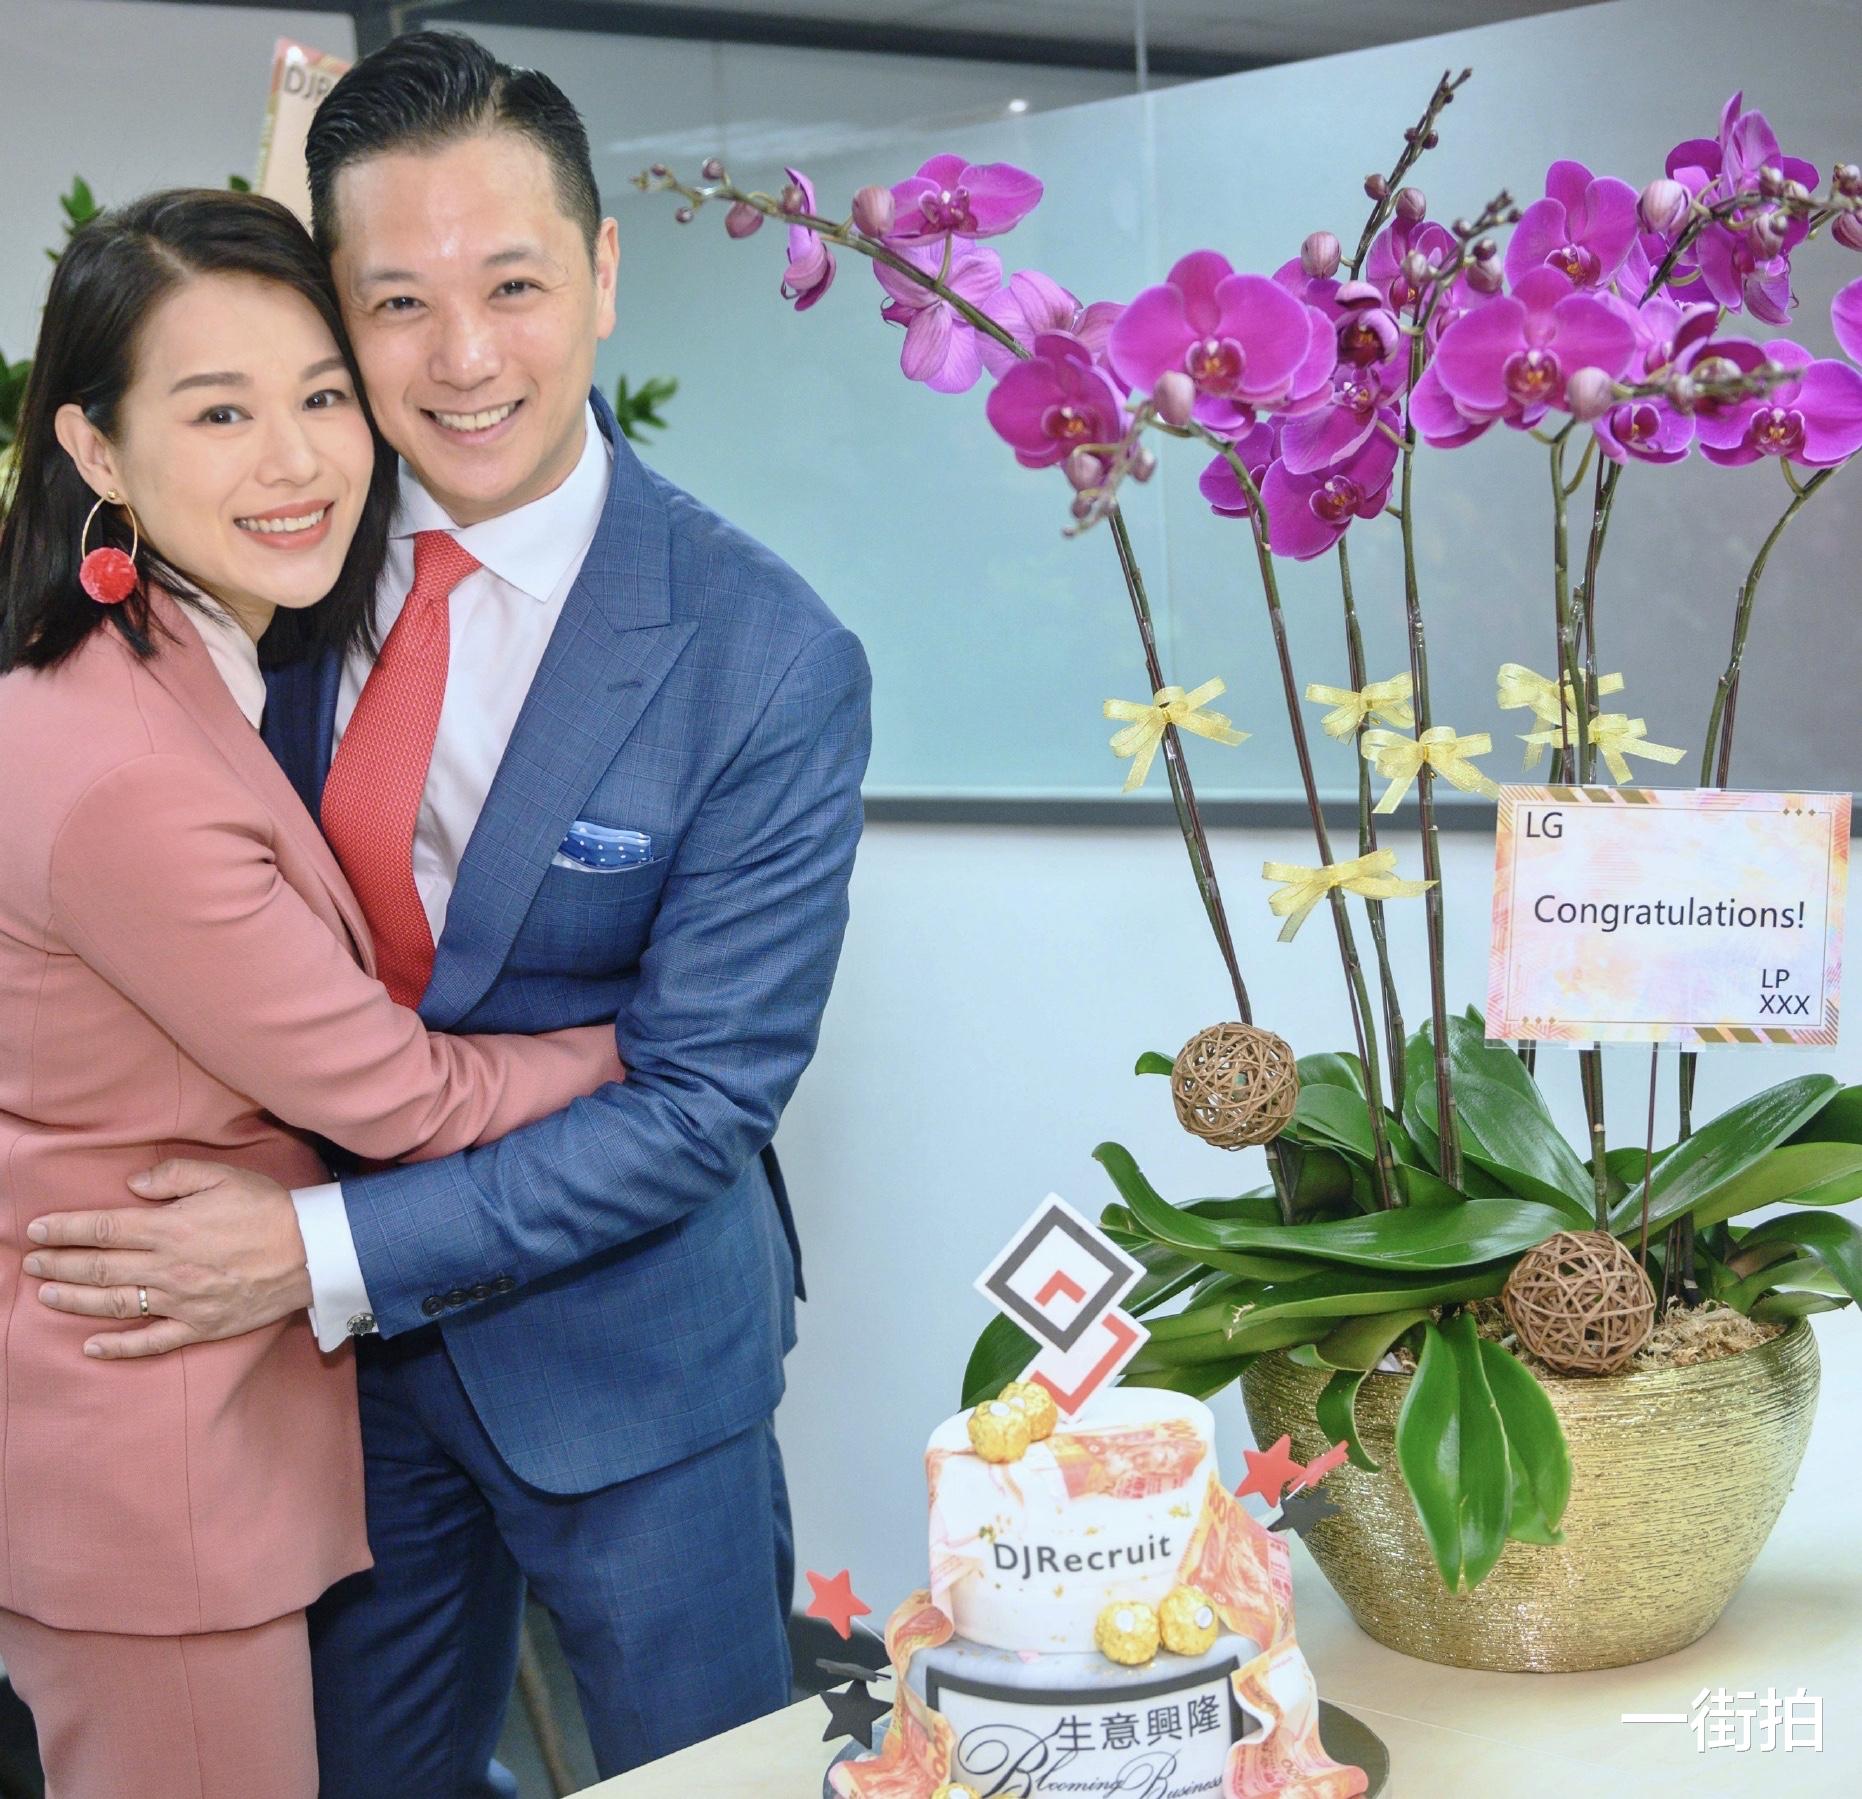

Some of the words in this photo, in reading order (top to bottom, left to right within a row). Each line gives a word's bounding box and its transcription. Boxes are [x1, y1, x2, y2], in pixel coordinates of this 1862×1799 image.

[1526, 812, 1563, 838] LG
[1534, 895, 1805, 932] Congratulations!
[1761, 968, 1790, 989] LP
[1759, 994, 1810, 1015] XXX
[993, 1534, 1171, 1580] DJRecruit
[1055, 1694, 1221, 1751] 生意興隆
